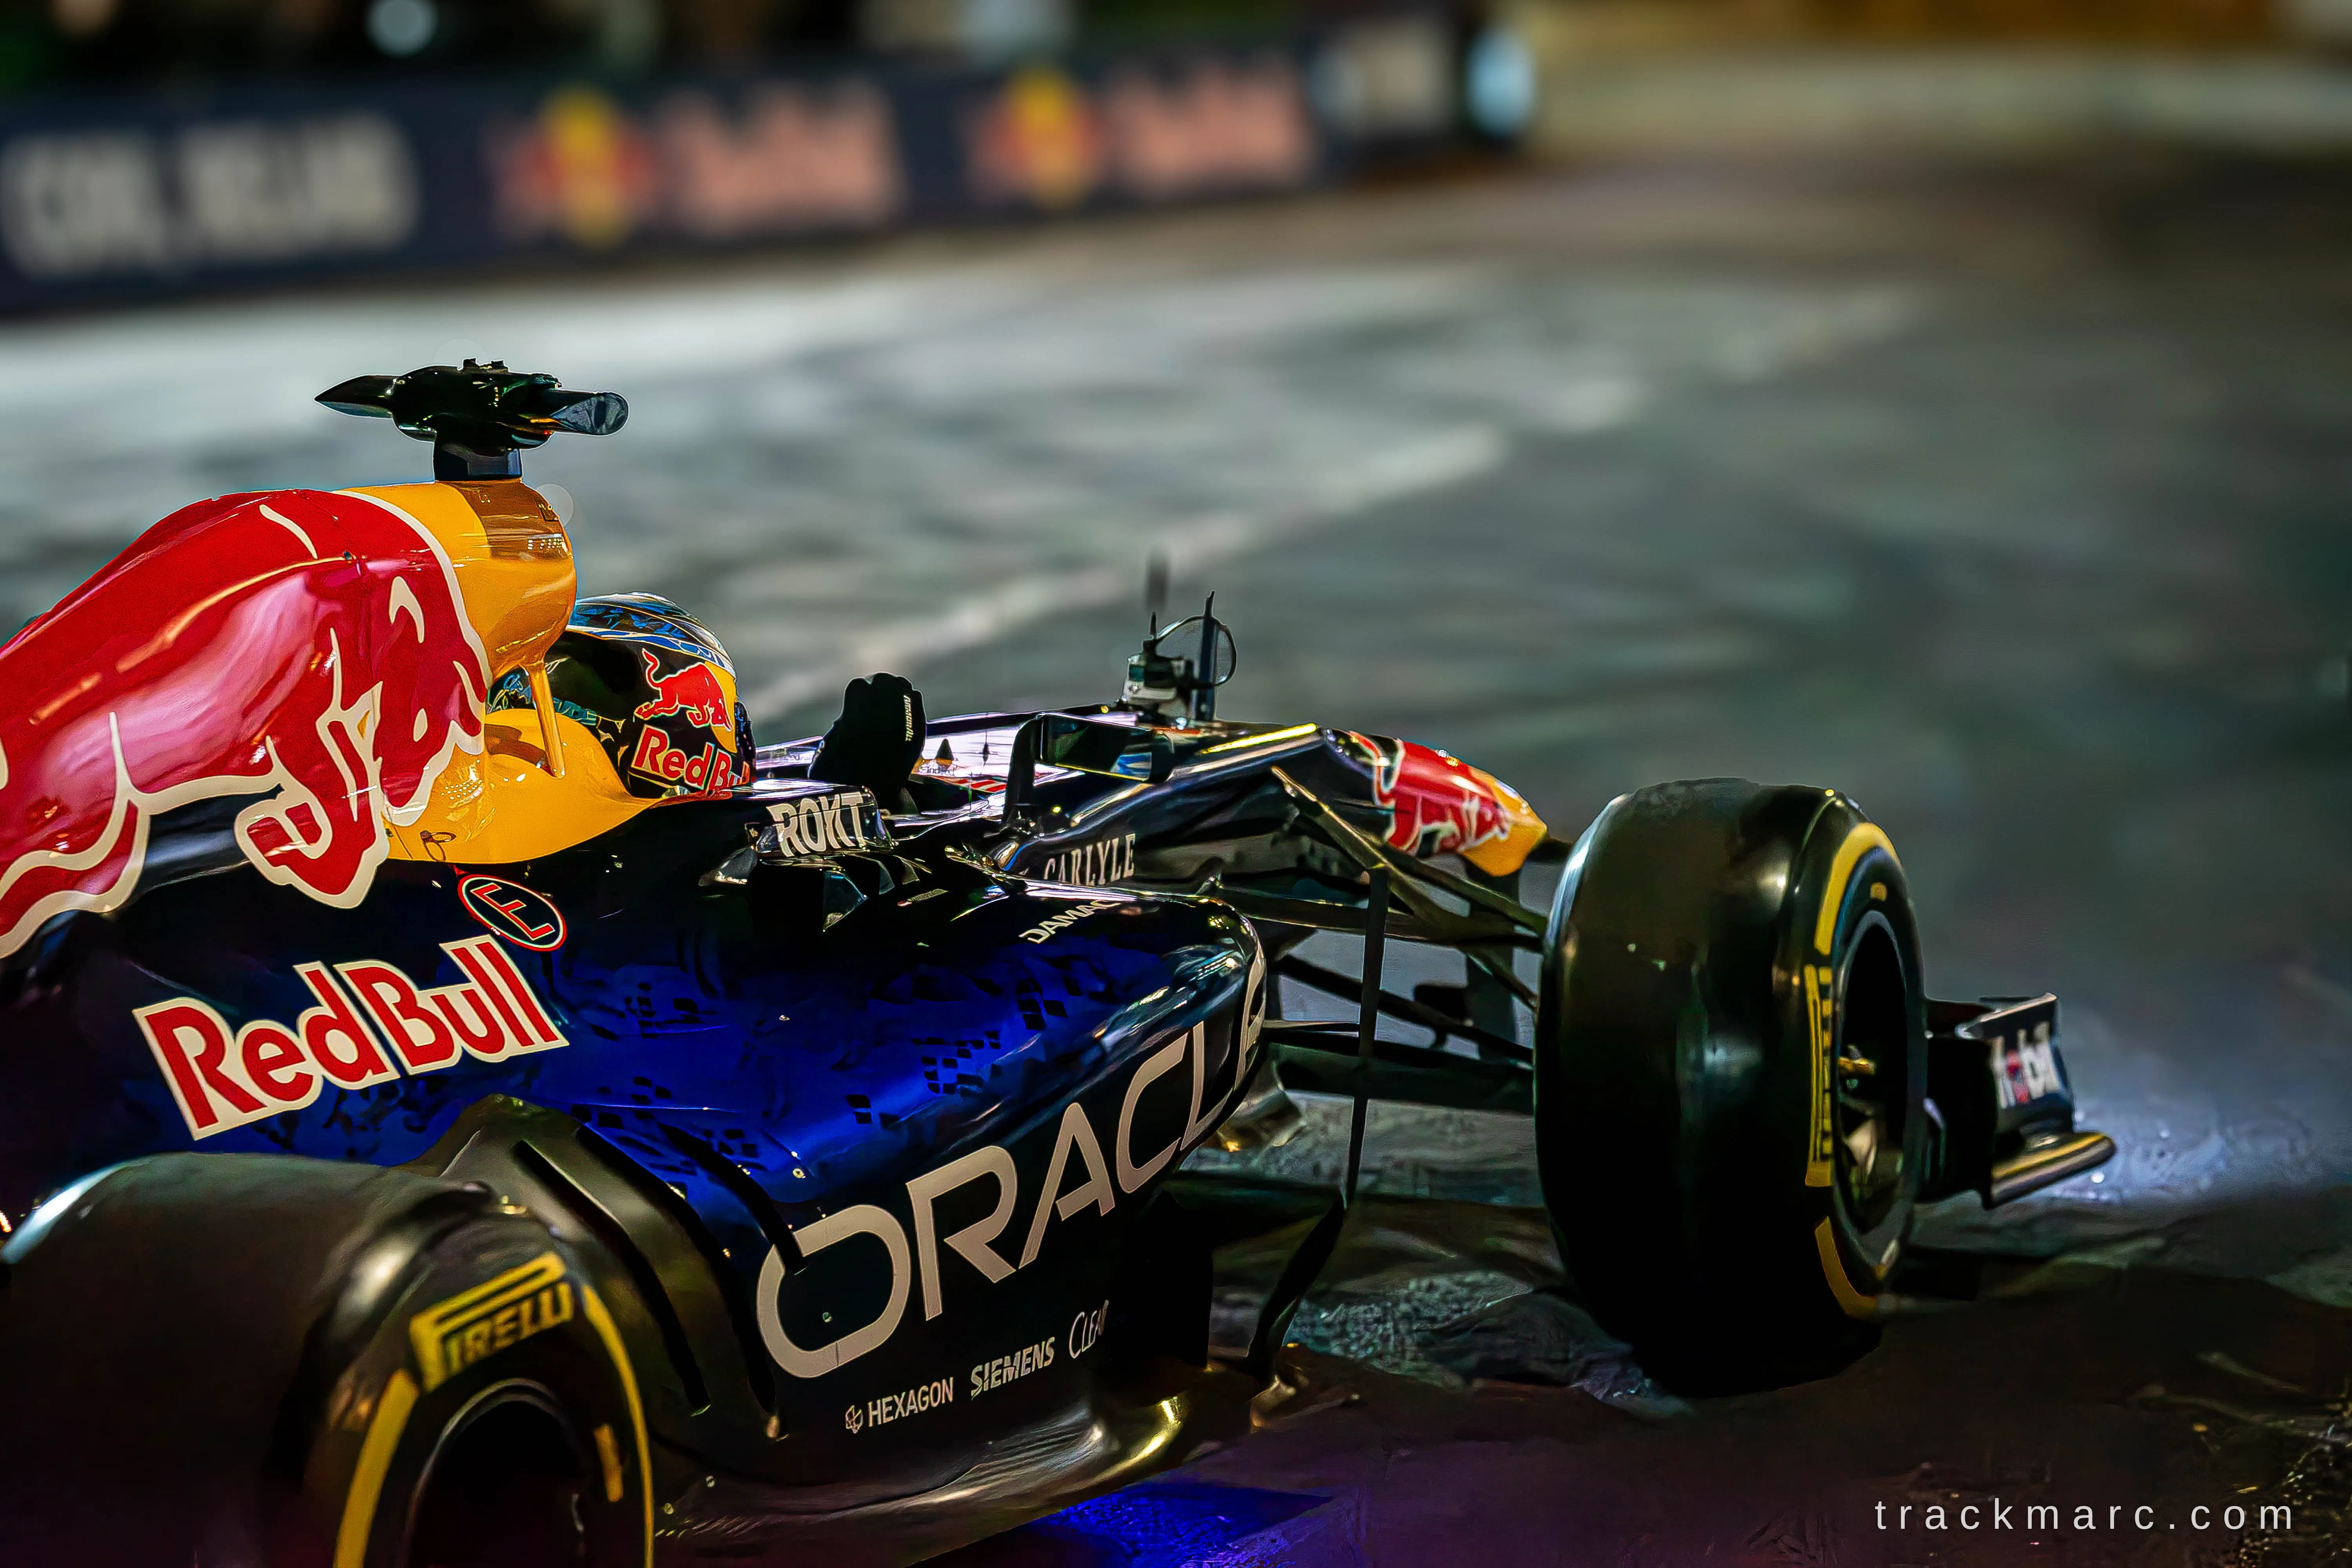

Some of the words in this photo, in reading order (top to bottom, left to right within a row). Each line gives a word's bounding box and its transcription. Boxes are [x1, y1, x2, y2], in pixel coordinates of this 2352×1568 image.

[766, 791, 866, 857] ROKT
[1043, 833, 1136, 886] CARLYLE
[1018, 899, 1121, 944] DAMAC
[409, 1252, 573, 1394] PIRELLI
[867, 1377, 954, 1427] HEXAGON
[971, 1337, 1055, 1399] SIEMENS
